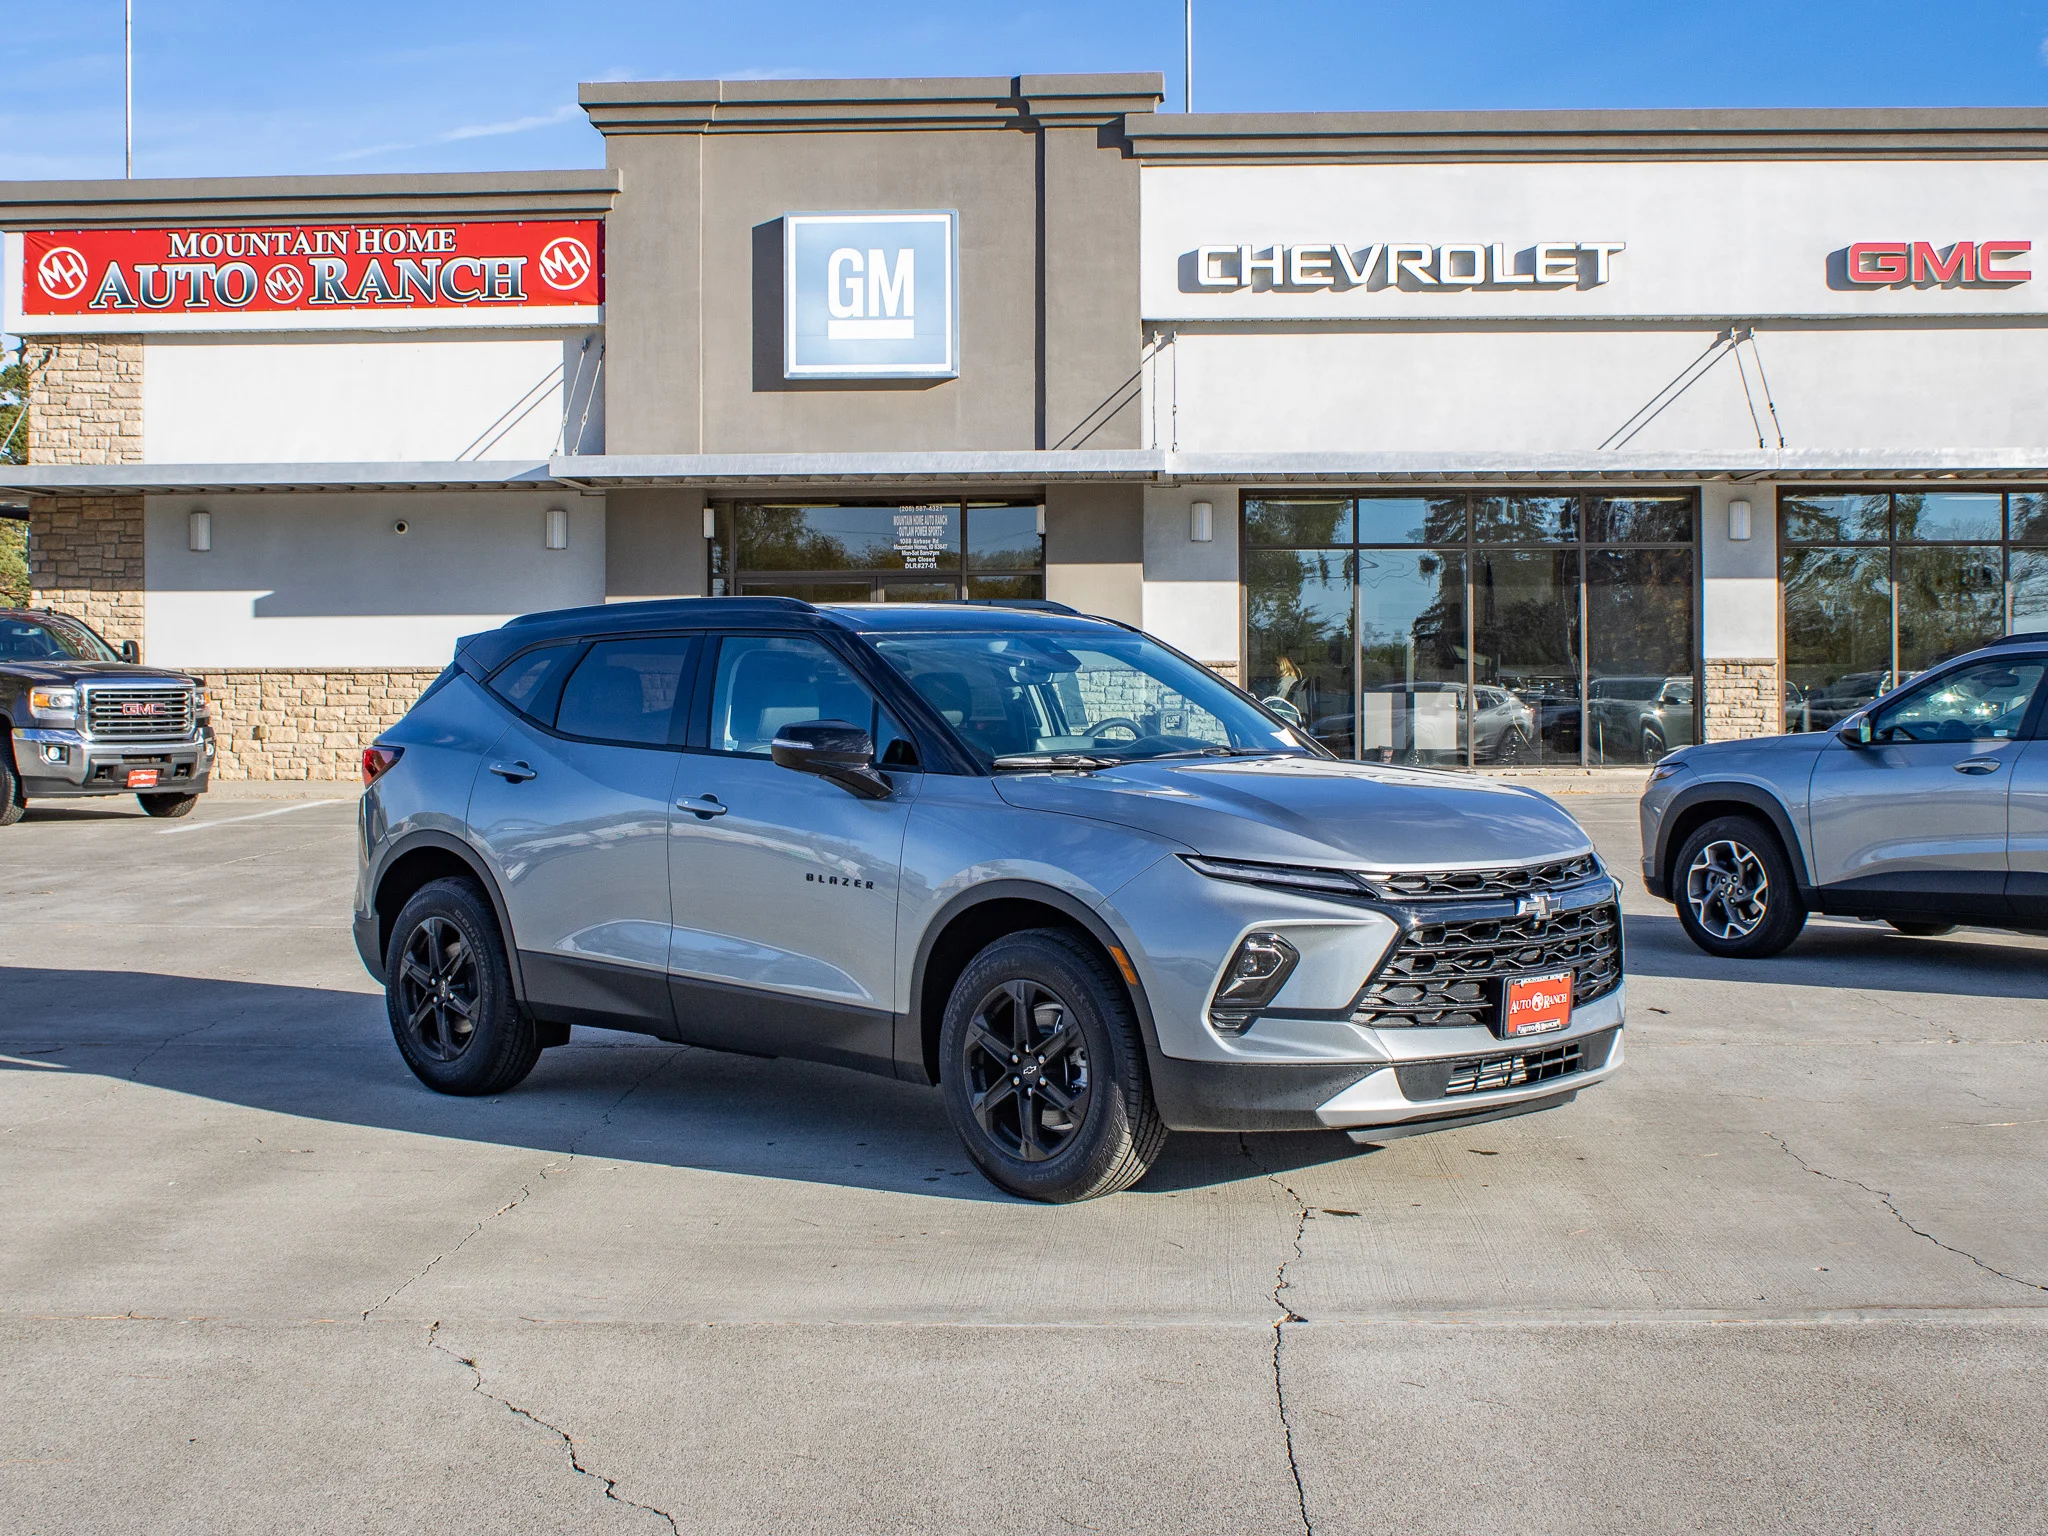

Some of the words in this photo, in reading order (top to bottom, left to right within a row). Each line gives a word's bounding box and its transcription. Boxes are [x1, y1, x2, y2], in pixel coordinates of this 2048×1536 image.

[167, 230, 350, 258] MOUNTAIN
[356, 228, 457, 254] HOME
[1197, 242, 1626, 286] CHEVROLET
[1847, 241, 2032, 283] GMC
[88, 260, 259, 310] AUTO
[308, 257, 528, 305] RANCH
[827, 247, 915, 319] GM
[915, 526, 927, 536] POWER
[928, 526, 942, 536] SPORTS
[925, 515, 934, 525] AUTO
[935, 515, 947, 525] RANCH
[122, 703, 165, 715] GMC
[806, 873, 874, 890] BLAZER
[1509, 999, 1531, 1014] AUTO
[1543, 993, 1567, 1008] RANCH
